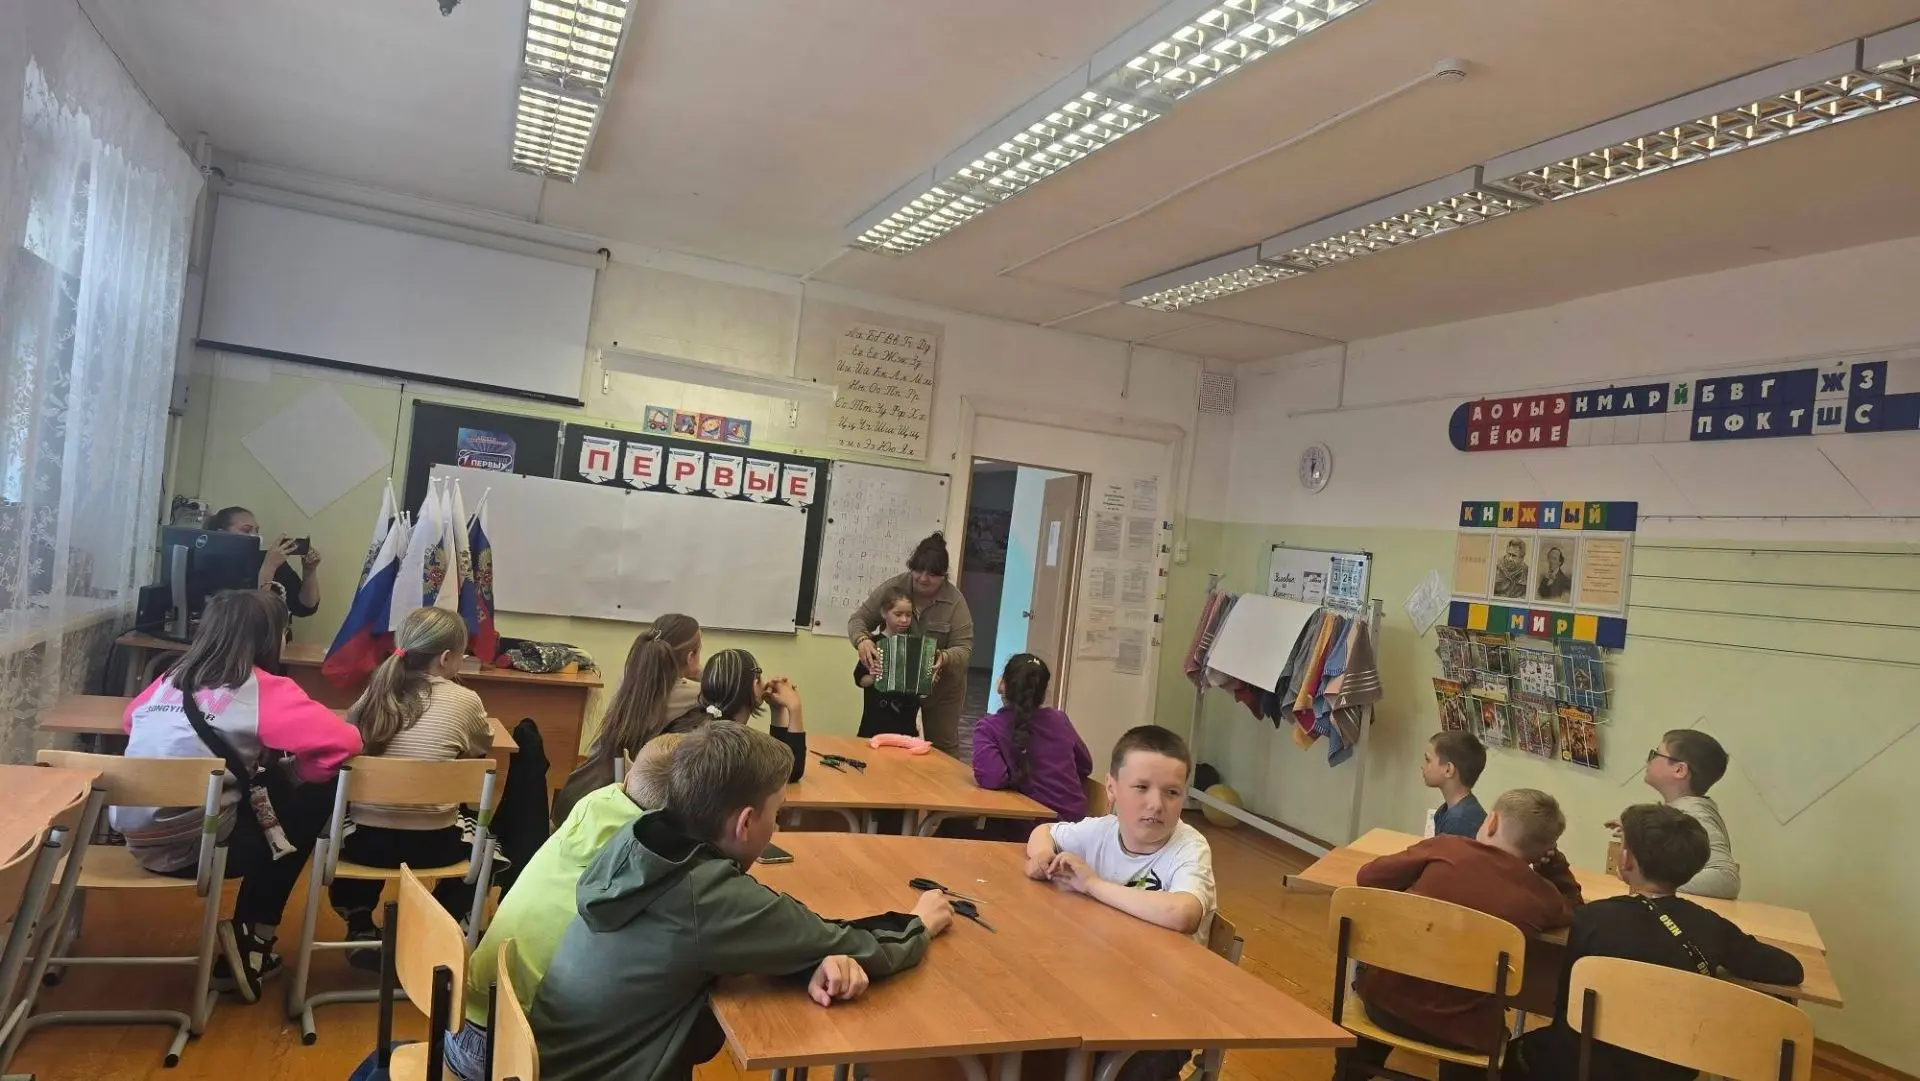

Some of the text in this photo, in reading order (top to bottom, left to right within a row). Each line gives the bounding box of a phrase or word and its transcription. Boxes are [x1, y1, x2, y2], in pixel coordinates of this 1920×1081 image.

[588, 449, 808, 497] ПЕРВЫЕ
[1464, 504, 1601, 524] КНИЖНЫЙ
[1511, 614, 1568, 635] МИР
